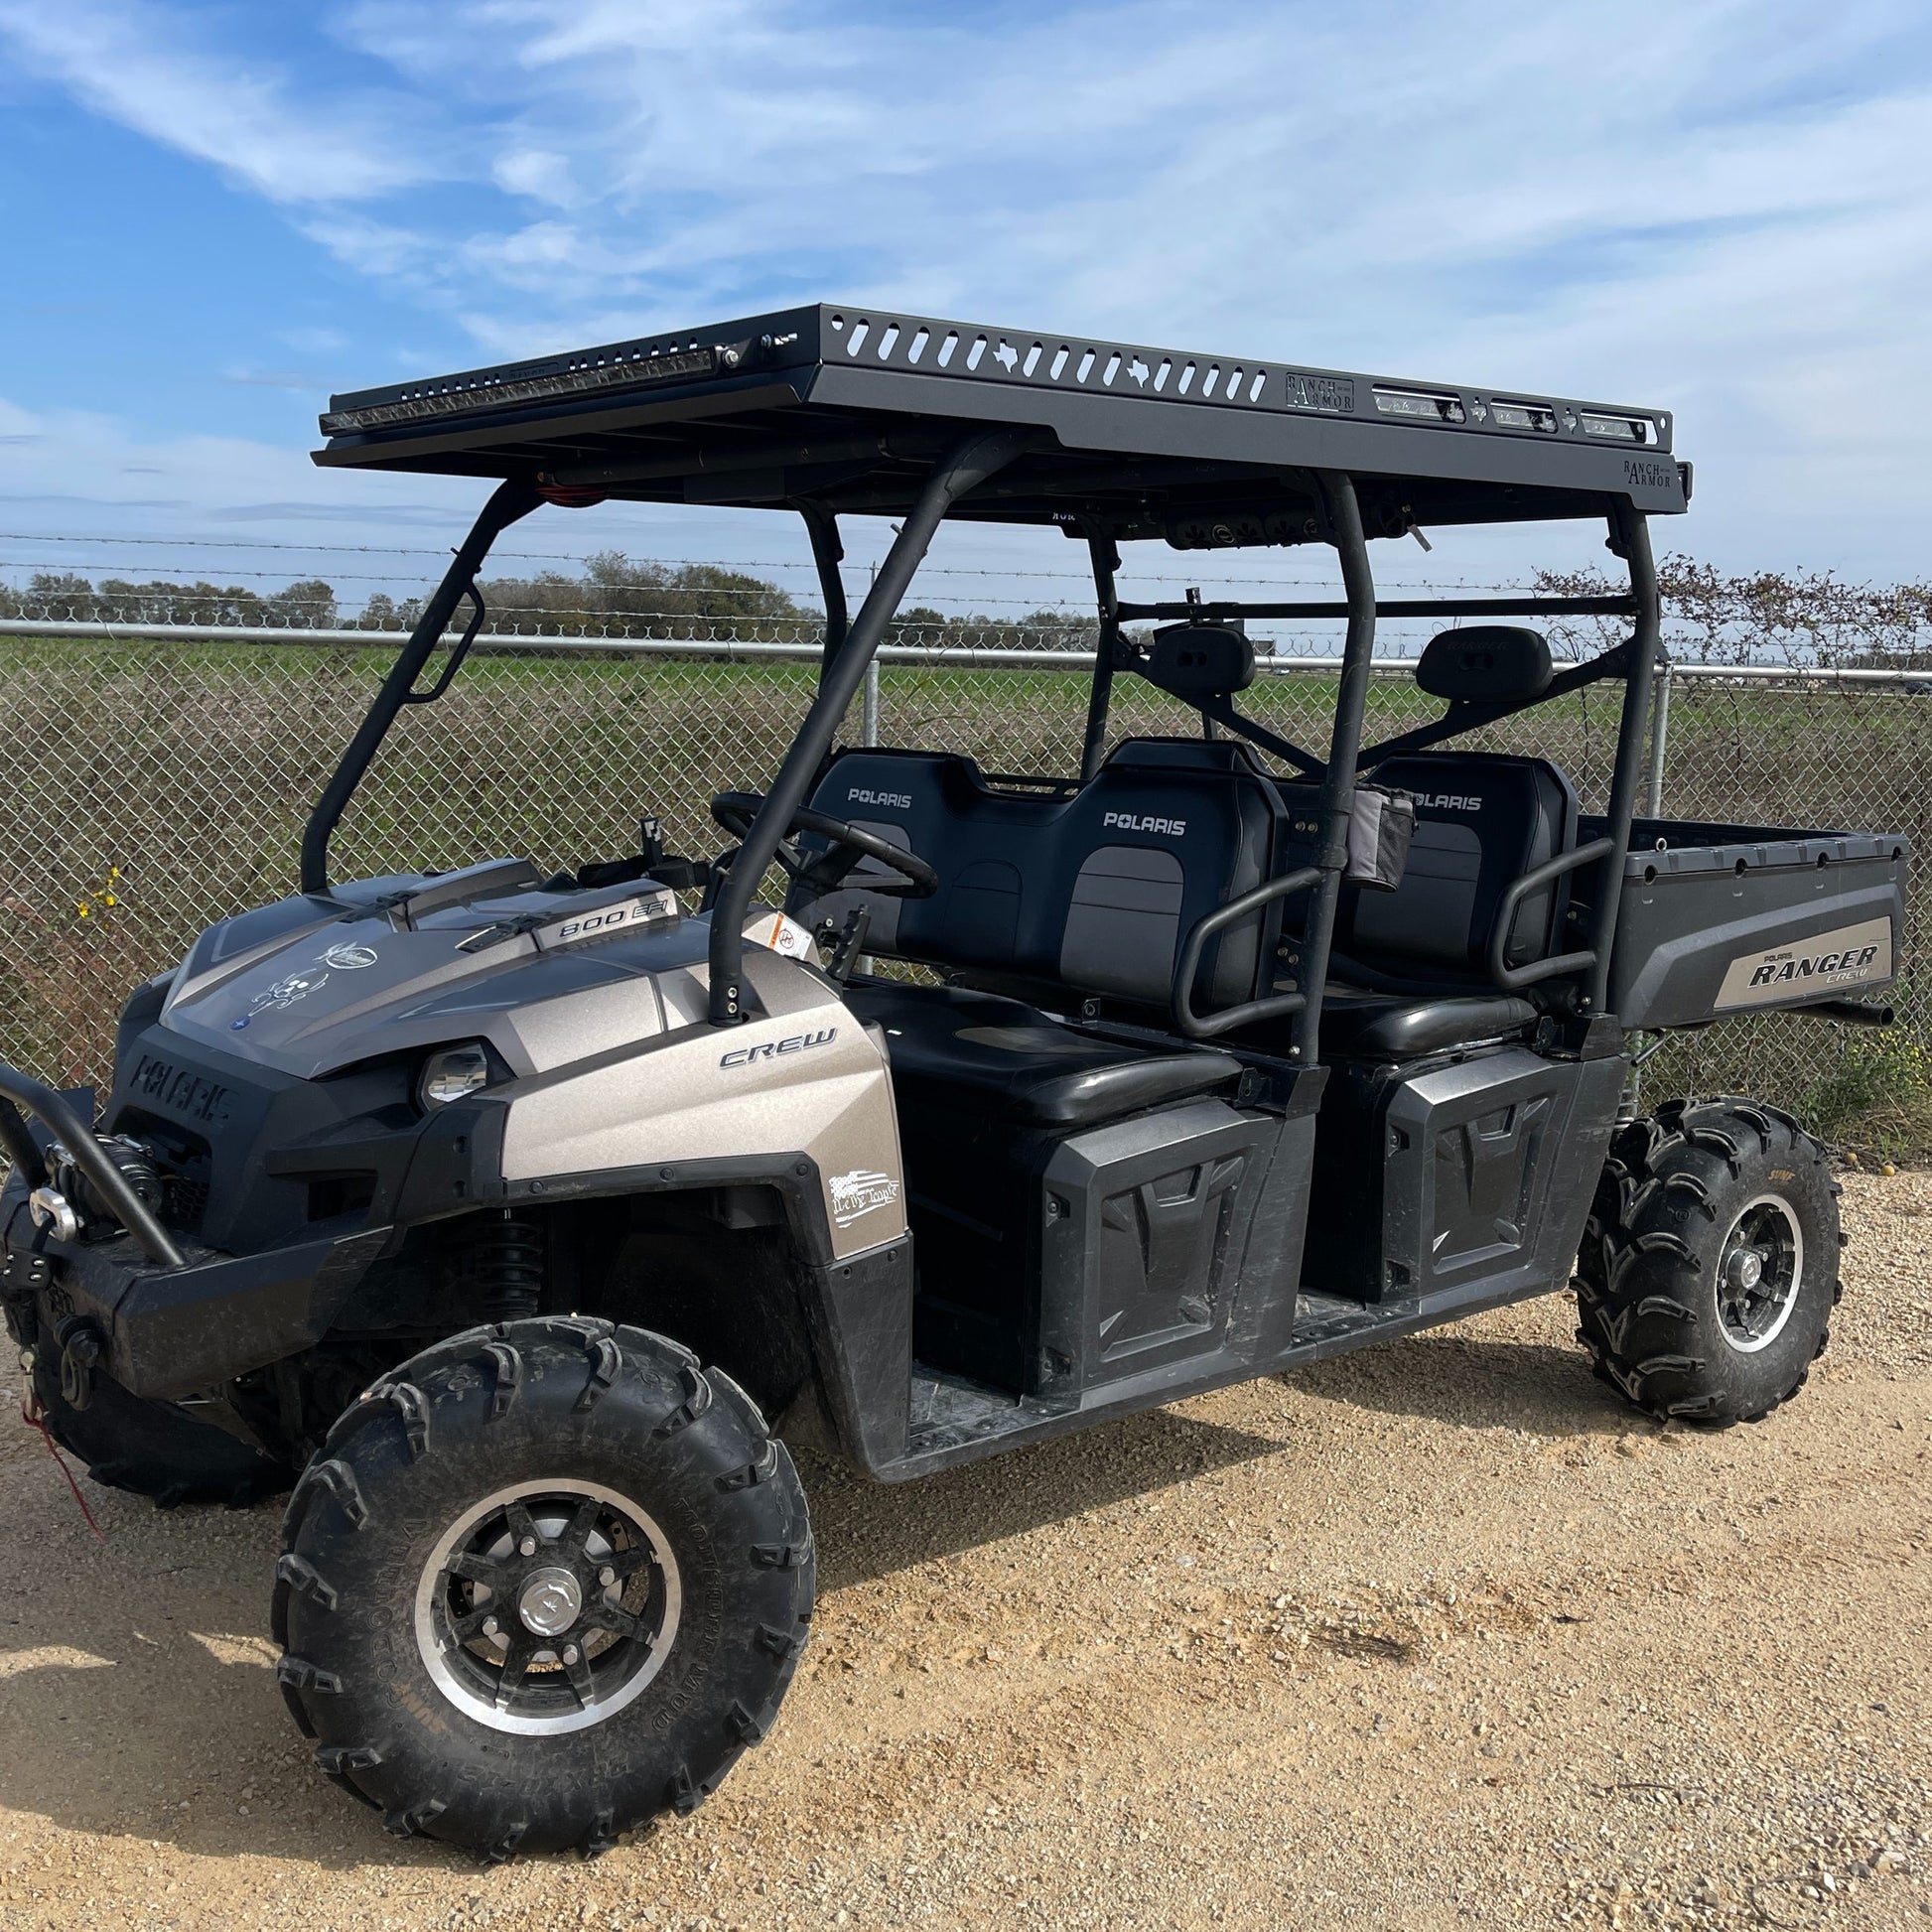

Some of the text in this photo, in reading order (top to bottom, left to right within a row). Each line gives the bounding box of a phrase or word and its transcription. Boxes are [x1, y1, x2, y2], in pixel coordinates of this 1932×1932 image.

[1288, 375, 1336, 400] RANCH
[1294, 380, 1352, 410] ARMOR
[1623, 460, 1660, 481] RANCH
[1627, 464, 1671, 487] ARMOR
[848, 787, 912, 809] POLARIS
[1413, 793, 1482, 811] OLARIS
[1103, 812, 1186, 836] POLARIS
[558, 899, 668, 938] 800 EFI
[1747, 944, 1879, 989] RANGER
[1763, 951, 1793, 963] POLARIS
[1826, 967, 1869, 984] CREW
[720, 1027, 838, 1069] CREW
[128, 1053, 240, 1123] POLARIS
